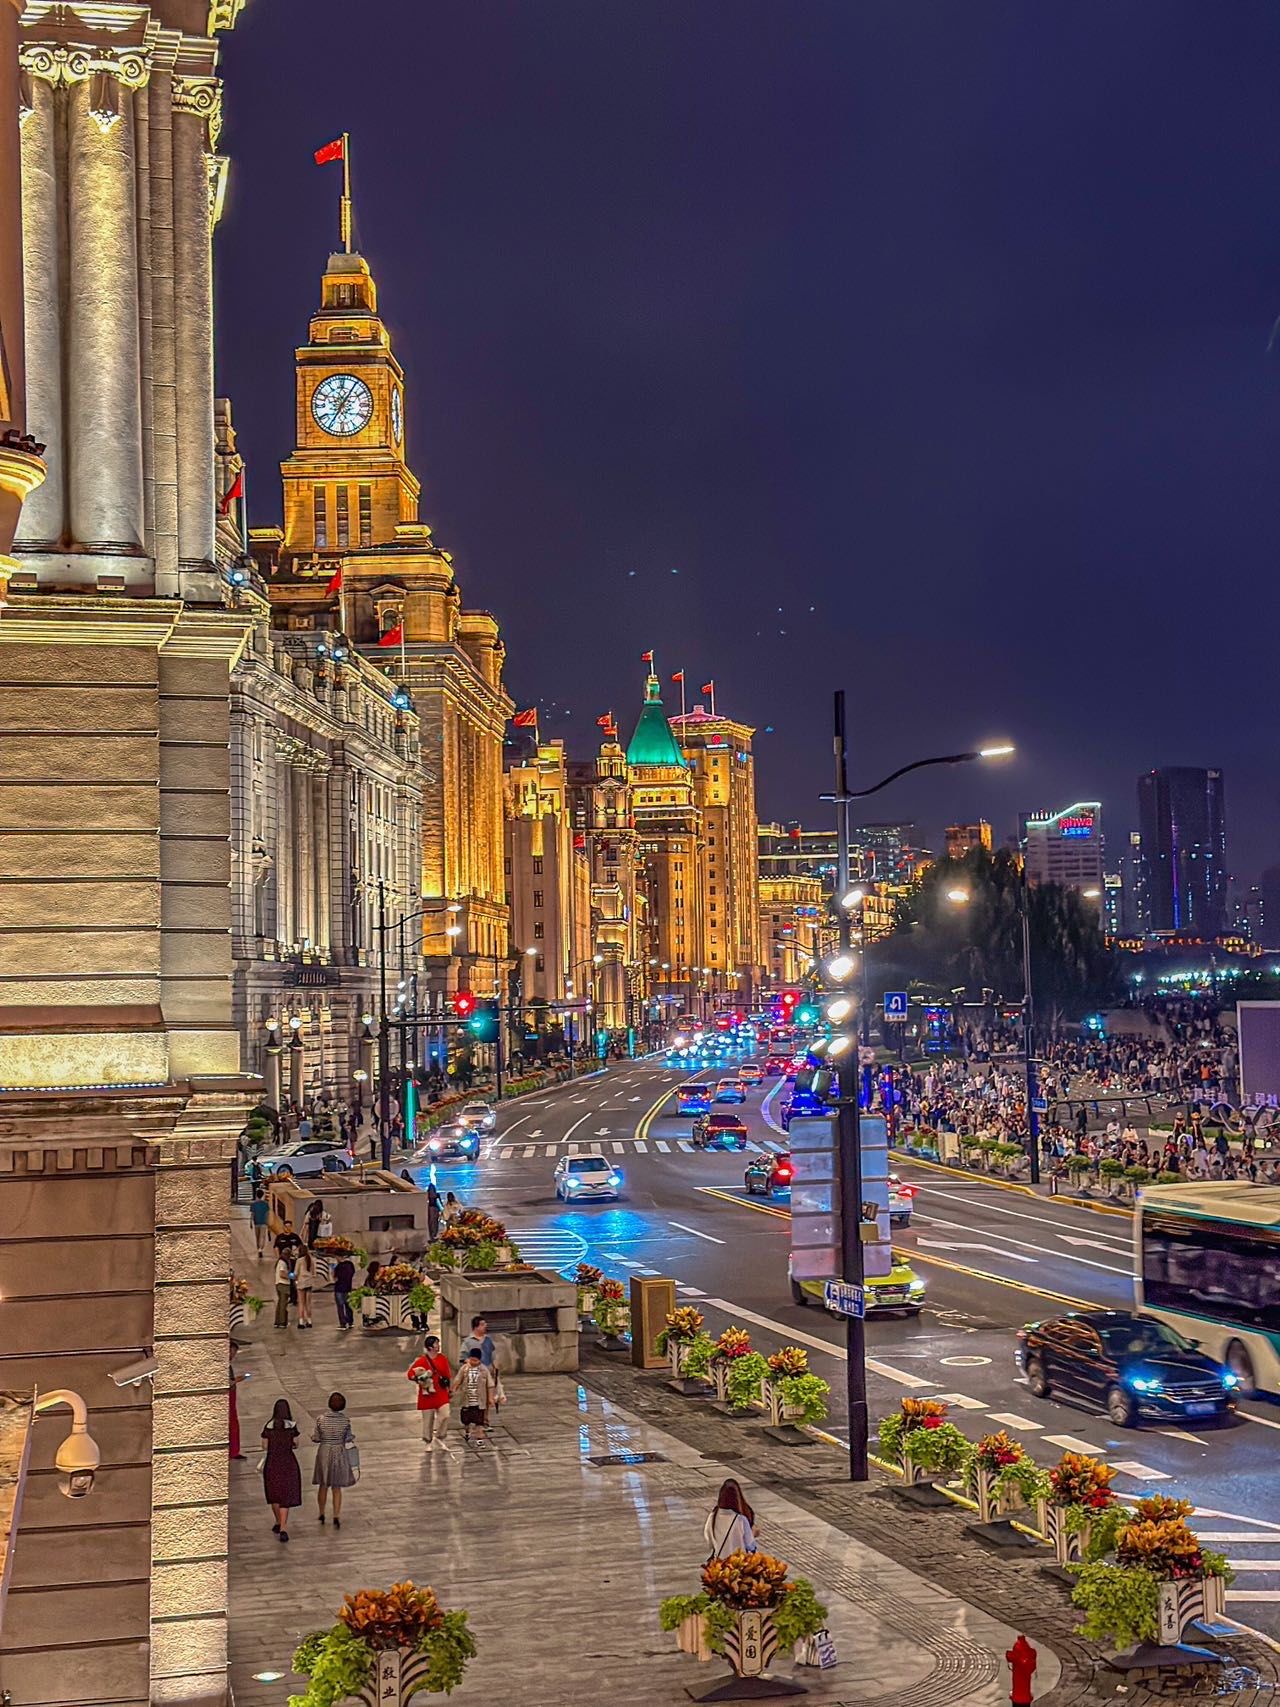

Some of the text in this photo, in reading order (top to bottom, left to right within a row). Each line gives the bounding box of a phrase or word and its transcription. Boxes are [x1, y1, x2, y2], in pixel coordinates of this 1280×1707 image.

[1163, 1596, 1176, 1630] 友善
[745, 1625, 758, 1659] 爱国
[382, 1666, 397, 1700] 敬业
